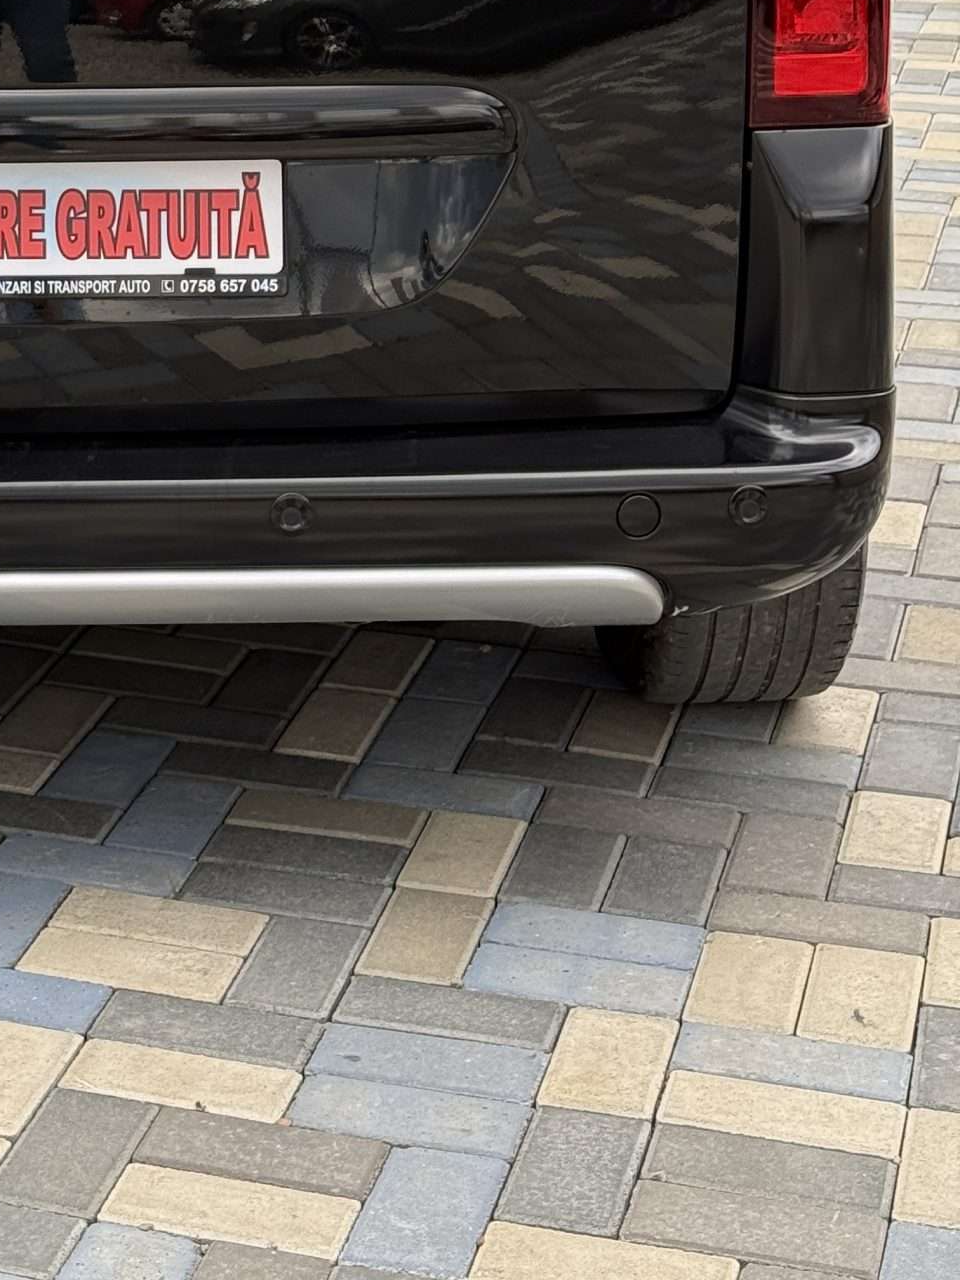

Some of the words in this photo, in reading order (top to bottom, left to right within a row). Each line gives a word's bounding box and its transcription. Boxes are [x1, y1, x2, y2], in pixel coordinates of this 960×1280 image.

[55, 172, 270, 260] GRATUITĂ
[34, 280, 45, 294] SI
[47, 280, 116, 294] TRANSPORT
[118, 280, 151, 293] AUTO
[180, 279, 215, 293] 0758
[219, 279, 247, 293] 657
[251, 279, 278, 293] 045
